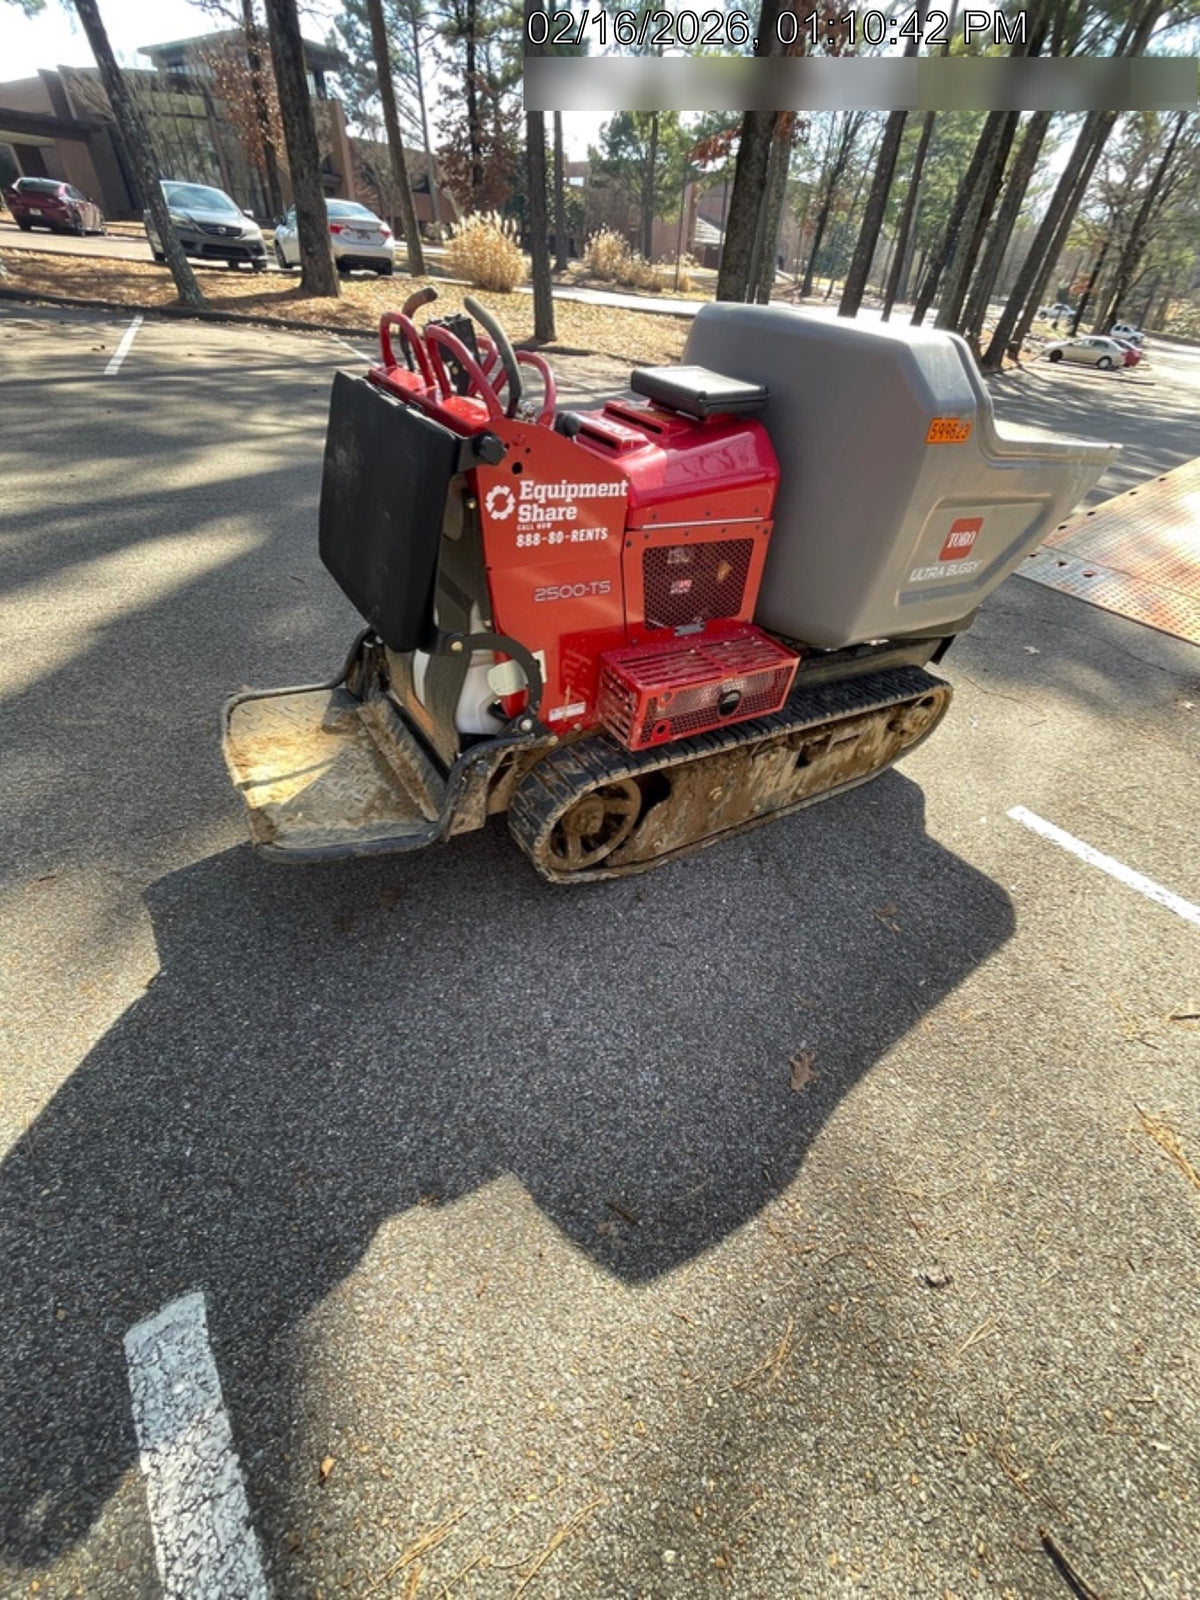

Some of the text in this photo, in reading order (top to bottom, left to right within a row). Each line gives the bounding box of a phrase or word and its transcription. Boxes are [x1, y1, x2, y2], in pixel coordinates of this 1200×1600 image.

[519, 480, 628, 503] Equipment
[518, 504, 577, 523] Share
[516, 527, 608, 547] 888-80-RENTS
[946, 531, 976, 548] TORO
[909, 560, 982, 582] ULTRA BUGGY
[534, 580, 611, 602] 2500-TS
